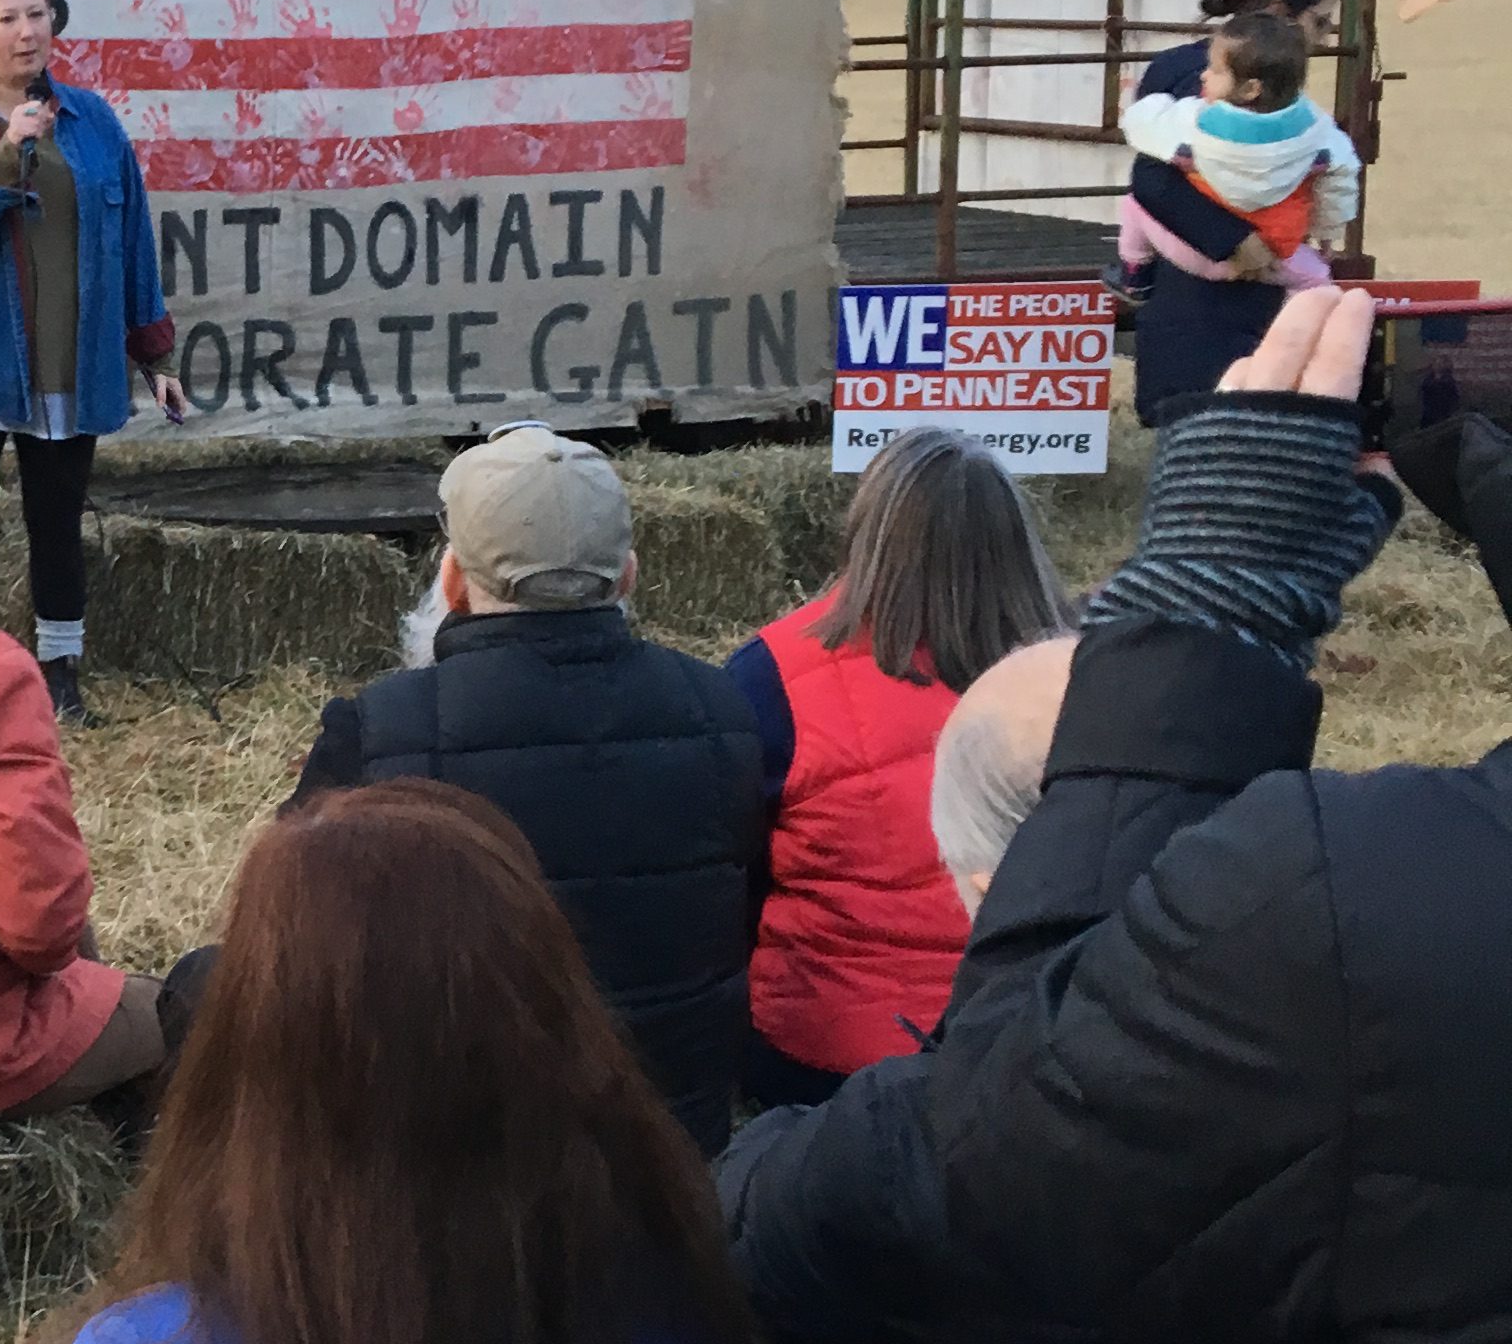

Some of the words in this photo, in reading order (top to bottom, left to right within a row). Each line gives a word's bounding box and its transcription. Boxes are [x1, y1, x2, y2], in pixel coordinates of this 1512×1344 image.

[309, 186, 665, 295] DOMAIN
[950, 295, 1003, 317] THE
[1009, 293, 1114, 317] PEOPLE
[842, 295, 946, 364] WE
[949, 330, 1034, 364] SAY
[1041, 329, 1108, 364] NO
[837, 376, 887, 406] TO
